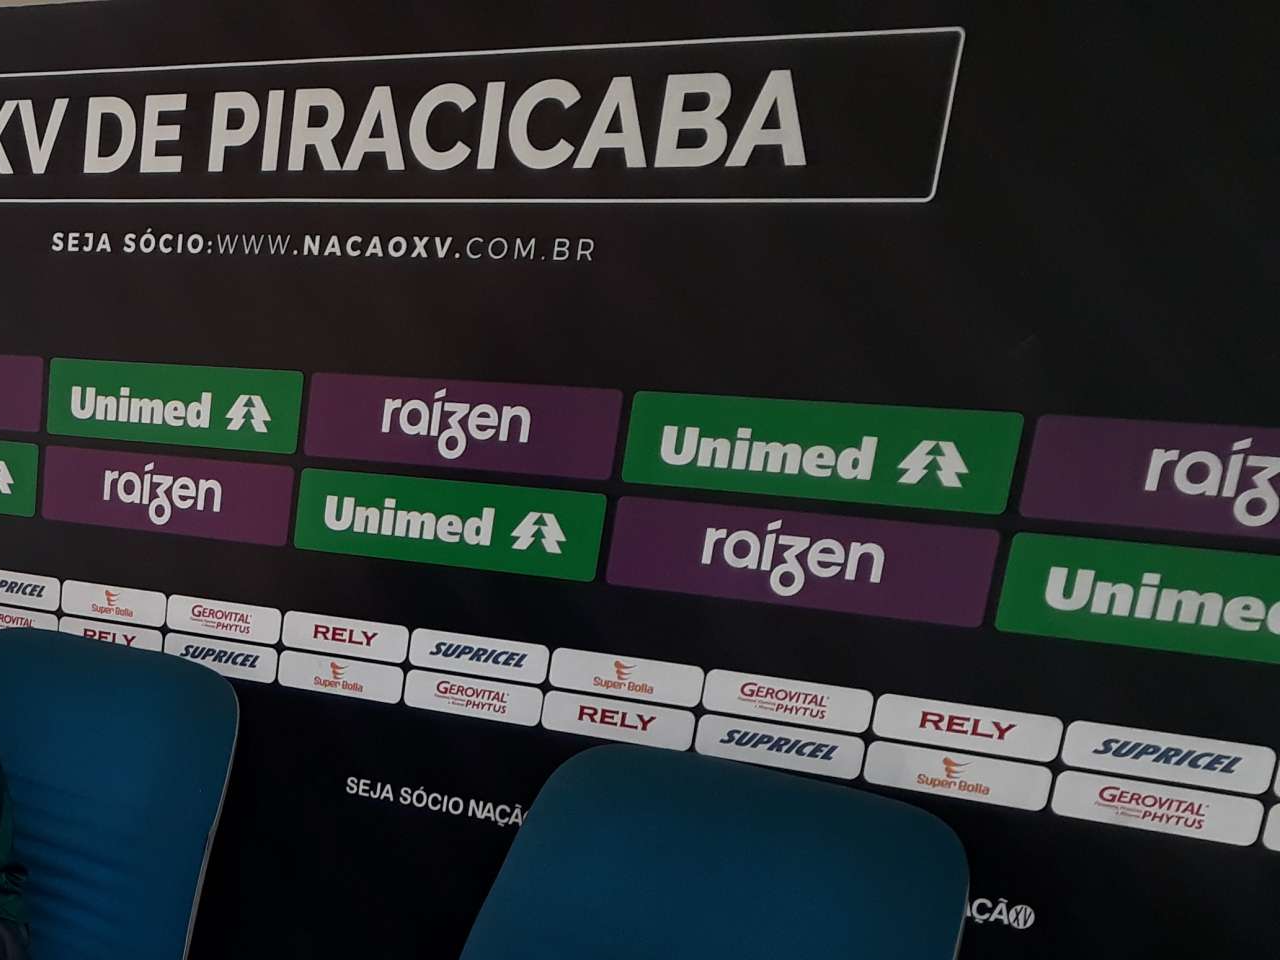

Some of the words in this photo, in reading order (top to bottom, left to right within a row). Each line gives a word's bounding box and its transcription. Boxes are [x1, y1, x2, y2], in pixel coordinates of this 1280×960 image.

[83, 93, 188, 174] DE
[207, 69, 807, 173] PIRACICABA
[51, 231, 112, 252] SEJA
[70, 386, 212, 428] Unimed
[659, 425, 879, 482] Unimed
[324, 495, 496, 546] Unimed
[91, 603, 115, 616] Super
[190, 604, 253, 625] GEROVITAL
[215, 621, 250, 635] PHYTUS
[312, 623, 379, 647] RELY
[179, 644, 261, 669] SUPRICEL
[429, 641, 529, 669] SUPRICEL
[313, 675, 341, 689] Super
[435, 679, 508, 704] GEROVITAL
[593, 675, 626, 691] Super
[739, 681, 828, 708] GEROVITAL
[465, 698, 507, 715] PHYTUS
[577, 704, 657, 732] RELY
[775, 702, 827, 720] PHYTUS
[919, 710, 1017, 741] RELY
[719, 728, 840, 762] SUPRICEL
[1092, 738, 1243, 775] SUPRICEL
[916, 772, 956, 790] Super
[346, 776, 394, 802] SEJA
[399, 786, 464, 815] SÓCIO
[468, 799, 529, 827] NAÇÃ
[1097, 786, 1206, 817] GEROVITAL
[1141, 809, 1205, 830] PHYTUS
